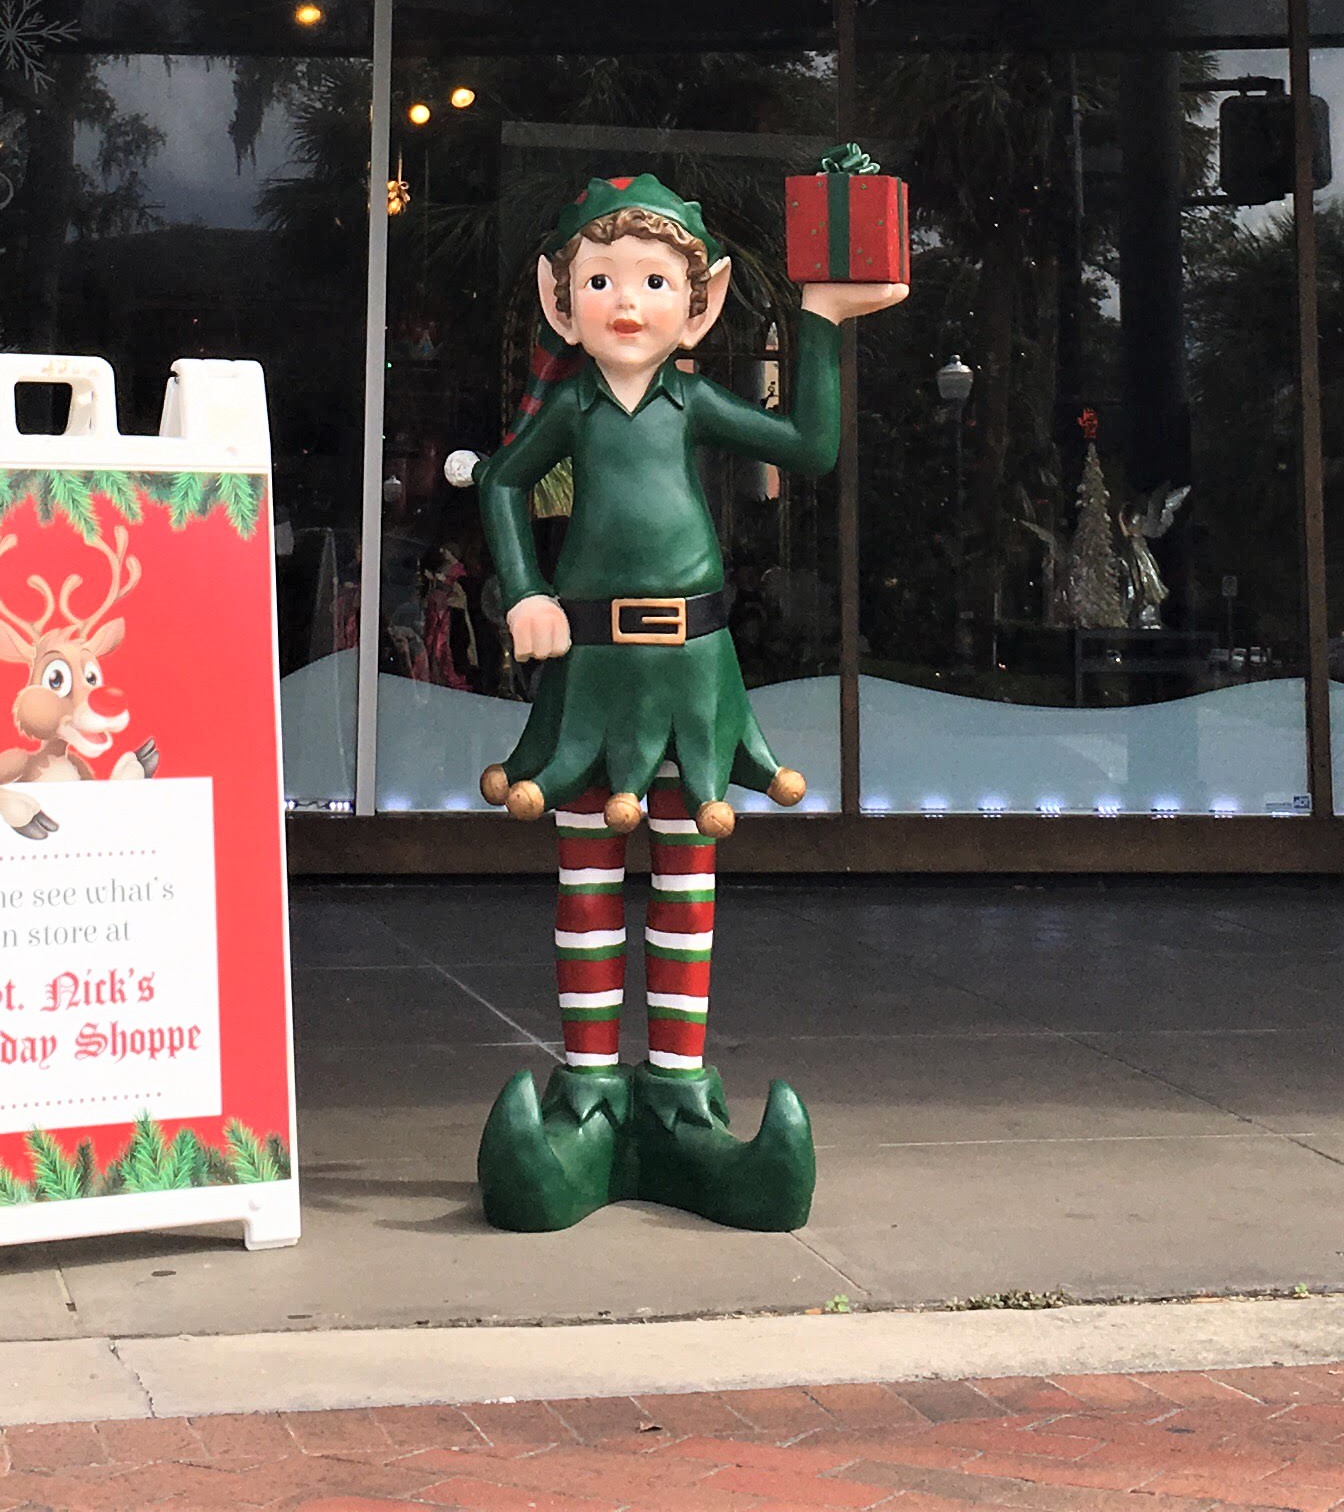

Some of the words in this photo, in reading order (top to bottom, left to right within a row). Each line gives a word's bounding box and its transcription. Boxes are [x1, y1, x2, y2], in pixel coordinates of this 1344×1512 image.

[32, 884, 77, 907] see
[85, 876, 176, 904] what's
[27, 923, 98, 947] store
[106, 919, 131, 943] at
[40, 967, 156, 1013] Nick's
[73, 1021, 203, 1064] Shoppe
